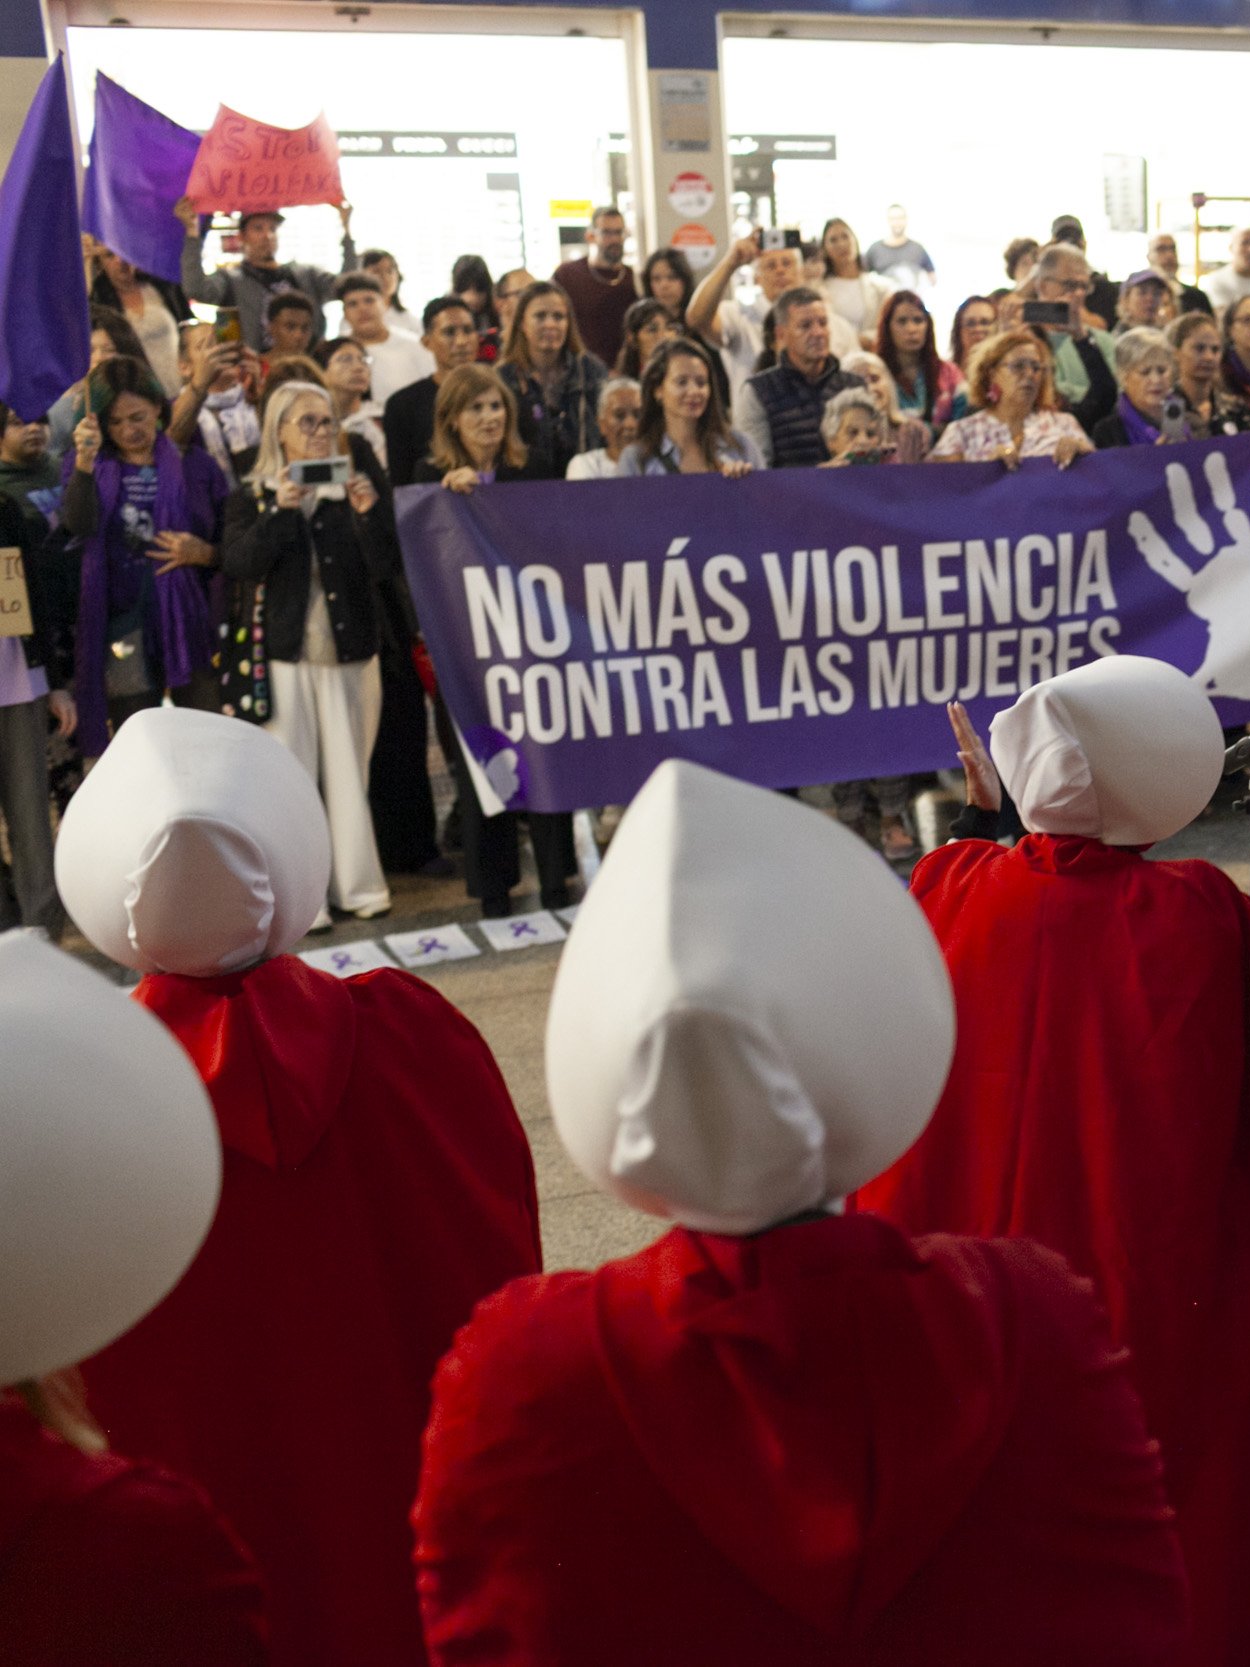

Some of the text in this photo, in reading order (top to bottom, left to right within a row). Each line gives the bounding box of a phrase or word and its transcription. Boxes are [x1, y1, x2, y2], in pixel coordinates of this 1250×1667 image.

[463, 528, 1118, 660] NO MÁS VIOLENCIA
[485, 650, 733, 745] CONTRA
[741, 641, 854, 723] LAS
